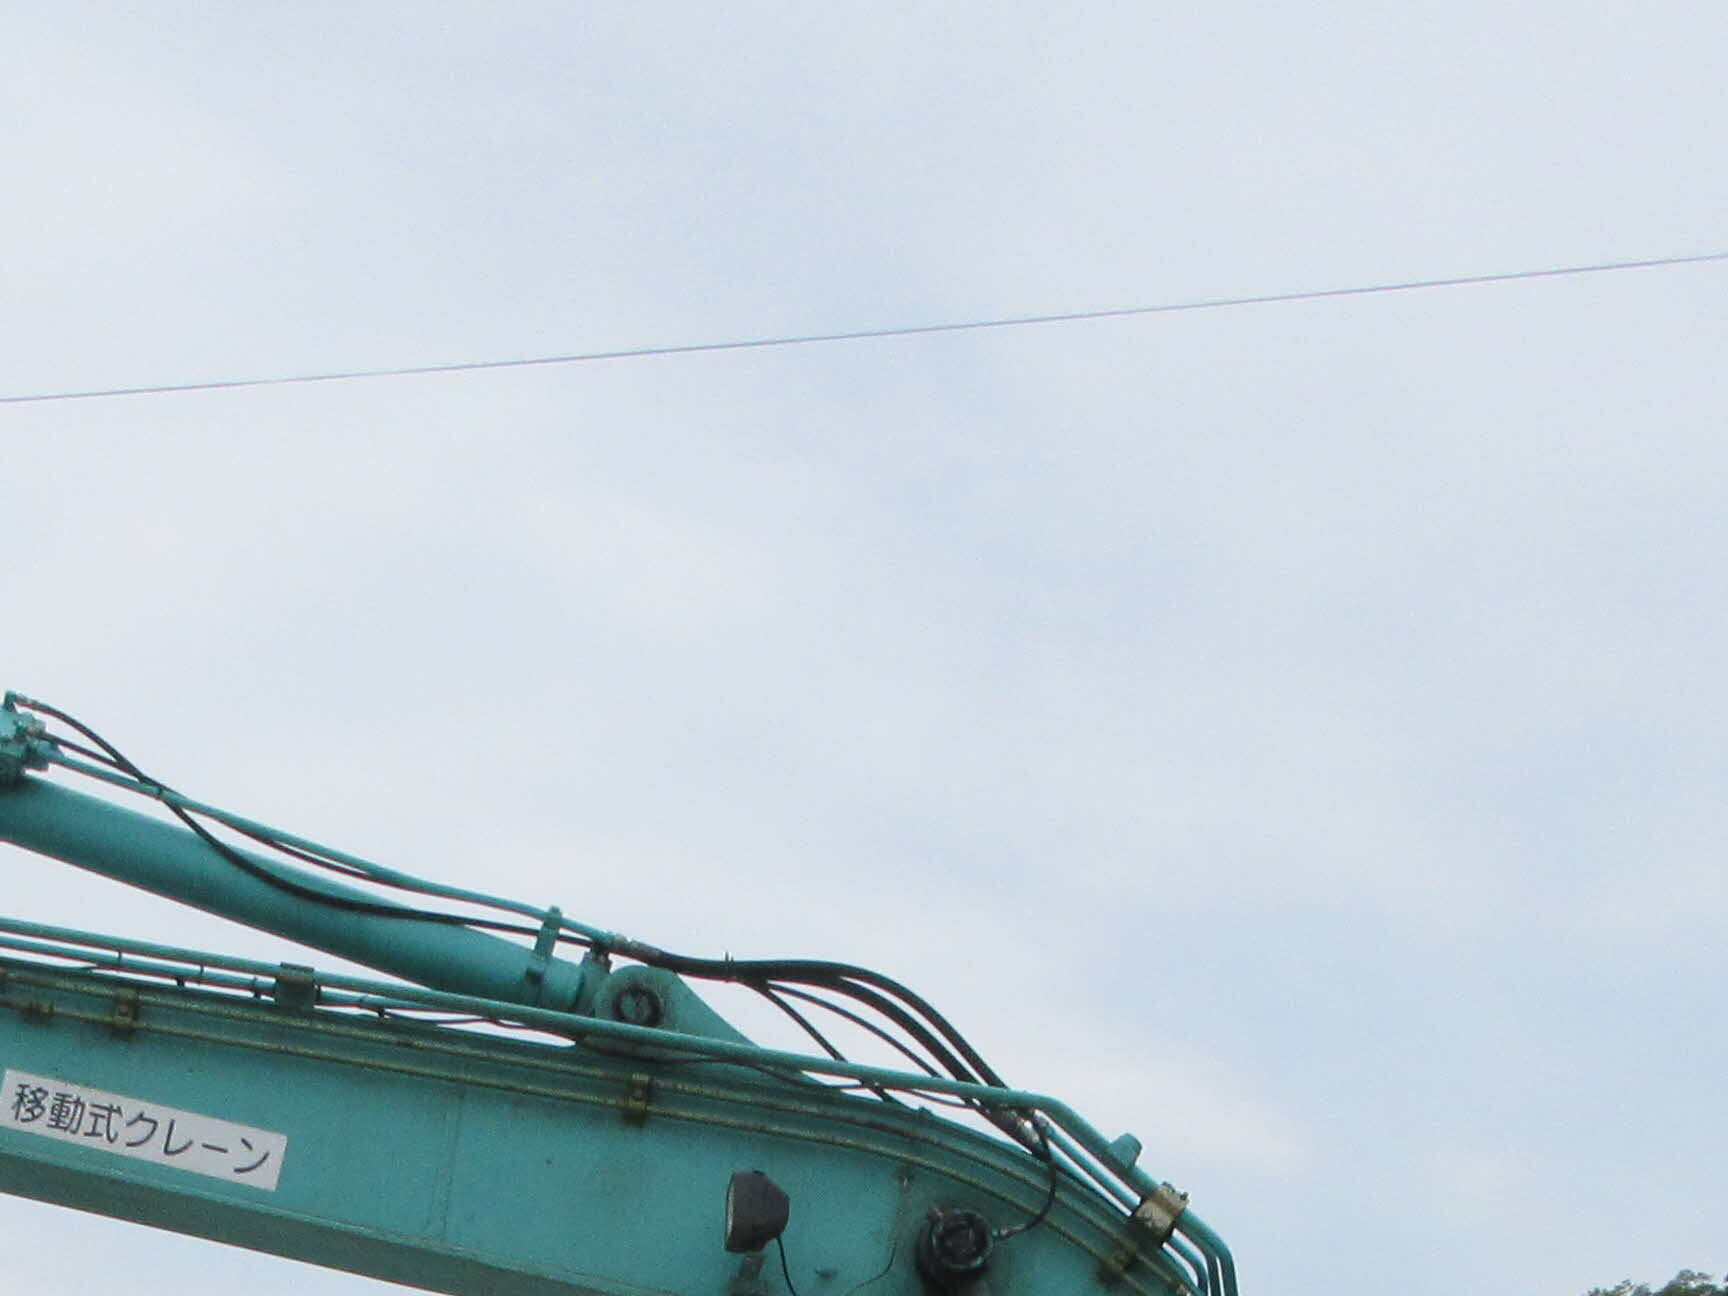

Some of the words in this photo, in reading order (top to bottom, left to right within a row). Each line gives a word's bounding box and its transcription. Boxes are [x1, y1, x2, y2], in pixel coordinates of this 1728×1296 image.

[11, 1083, 269, 1174] 移動式クレーン
